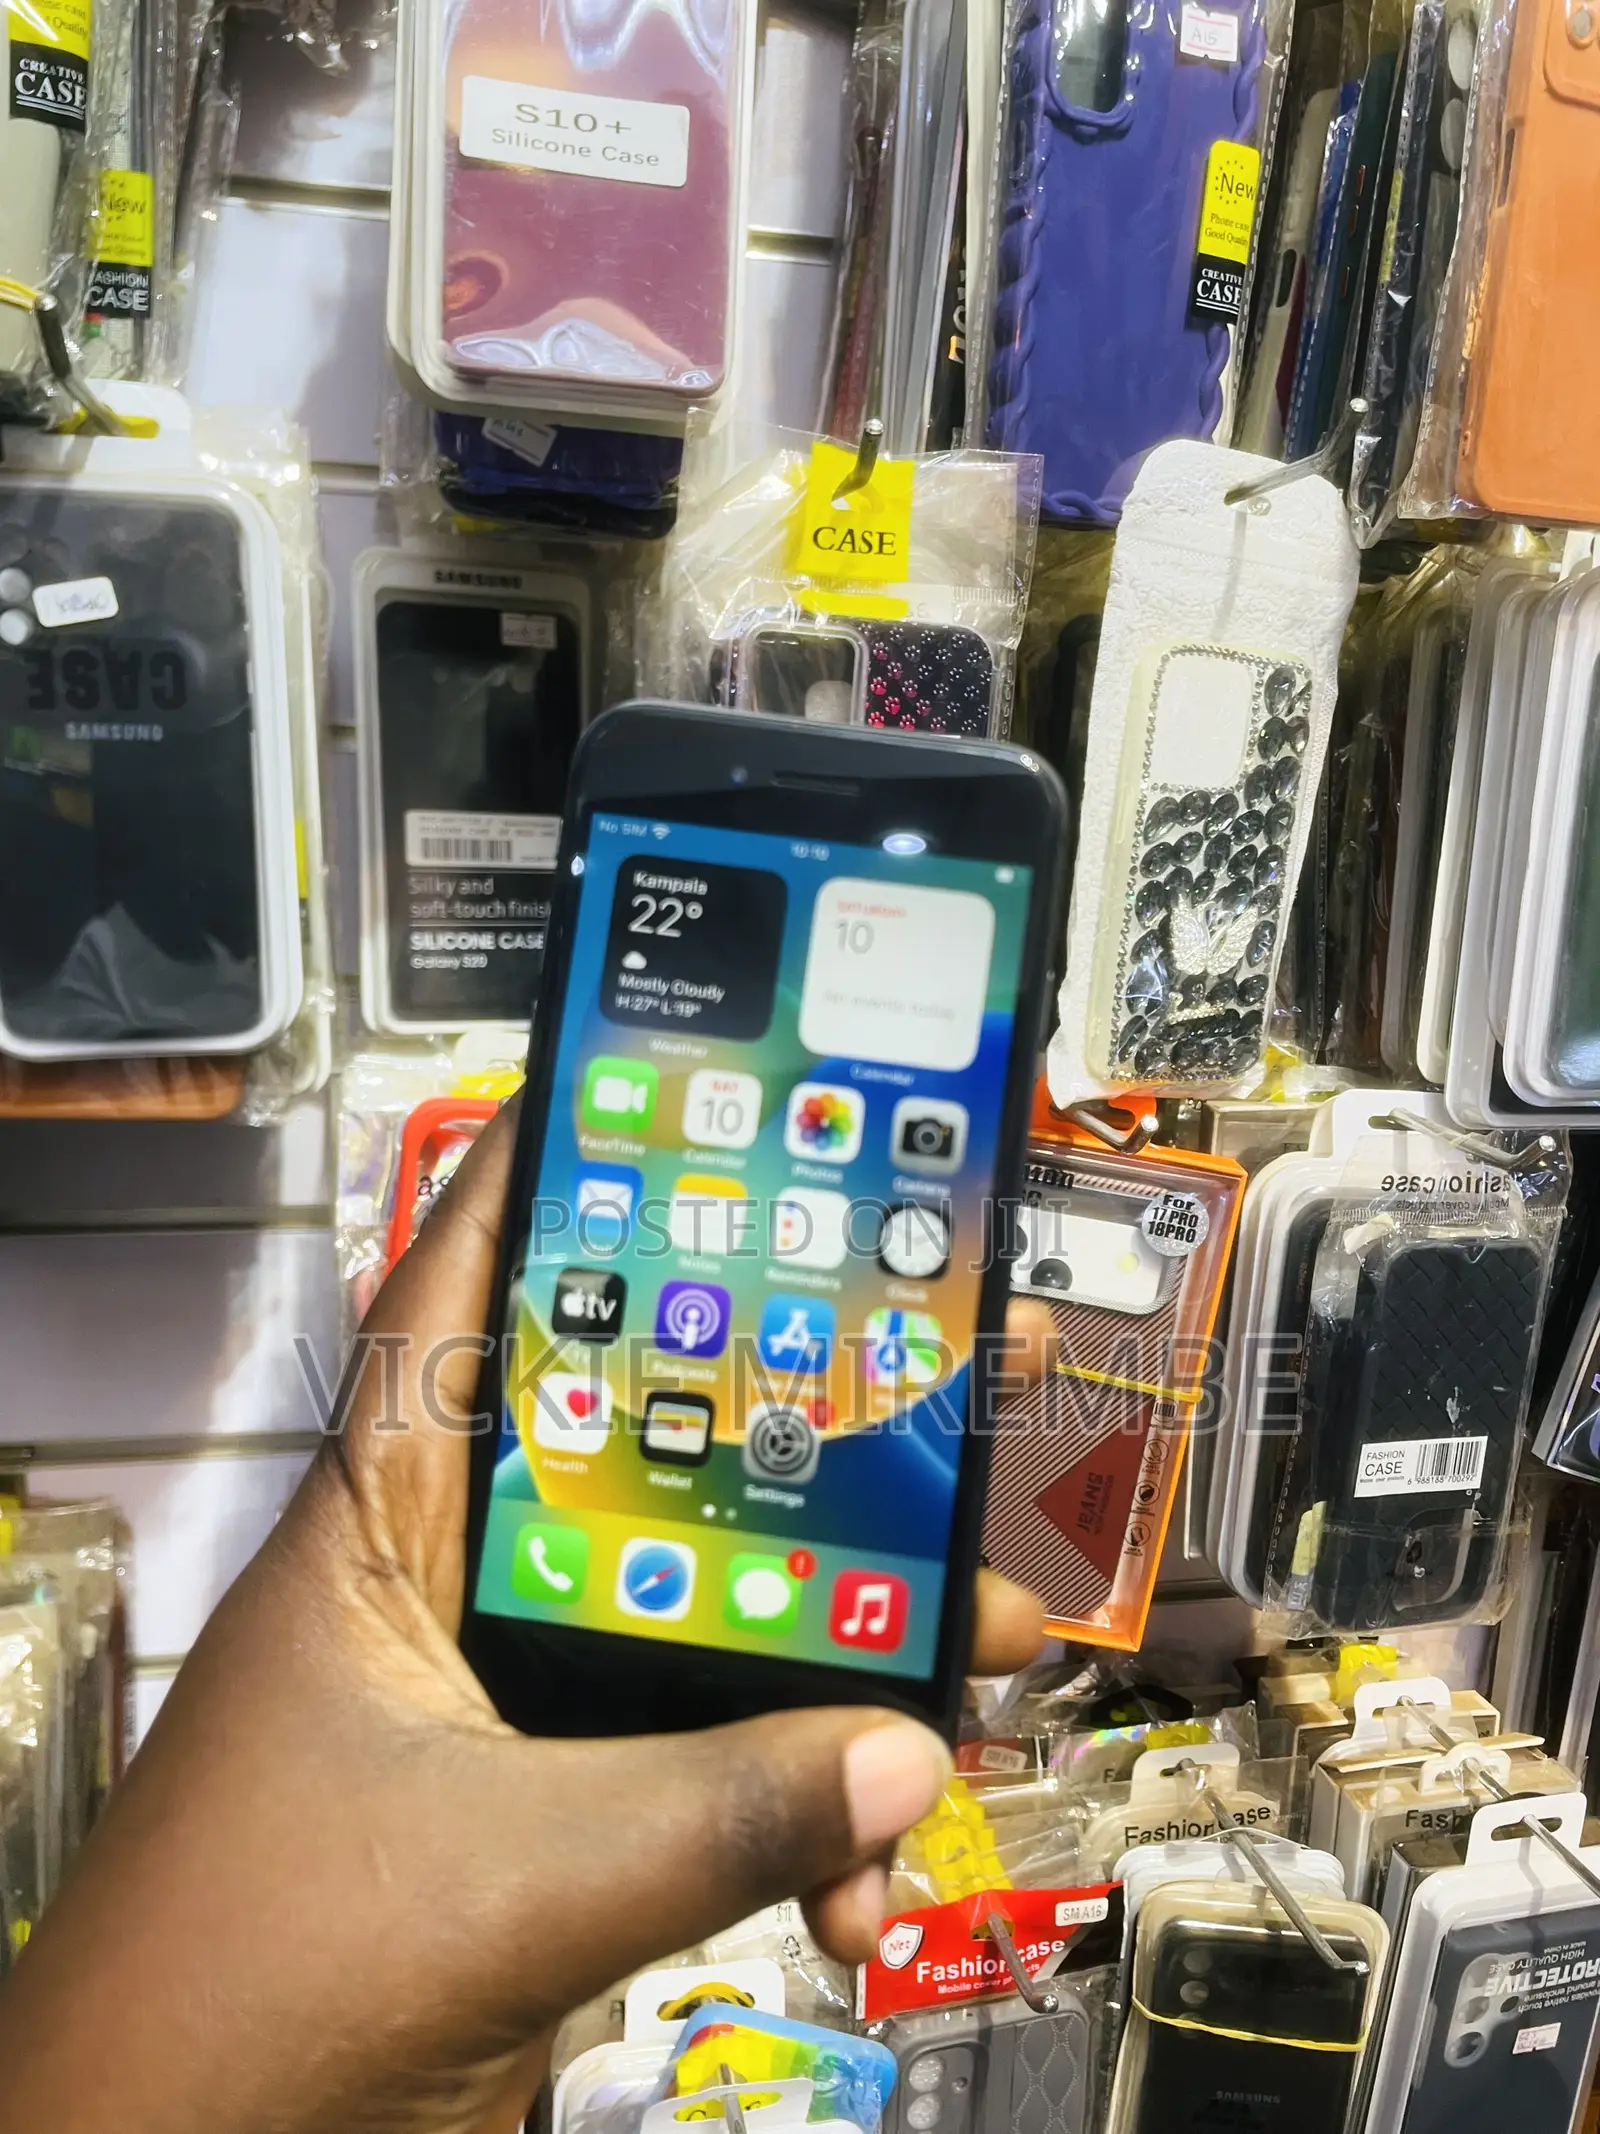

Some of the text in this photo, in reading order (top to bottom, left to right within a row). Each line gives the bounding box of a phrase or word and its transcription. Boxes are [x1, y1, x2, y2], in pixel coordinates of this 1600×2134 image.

[514, 103, 632, 135] S10+
[492, 128, 660, 168] Silicone Case
[1221, 172, 1255, 201] New
[1210, 213, 1235, 228] Phone
[1205, 227, 1226, 241] Good
[93, 270, 149, 288] ASHION
[84, 285, 149, 312] CASE
[812, 526, 898, 556] CASE
[64, 719, 164, 742] SAMSUNG
[458, 878, 494, 895] and
[633, 869, 708, 896] Kampala
[627, 893, 704, 938] 22°
[409, 931, 544, 951] SILICONE CASE
[834, 918, 875, 955] 10
[618, 972, 725, 1005] Mostly Cloudy
[701, 1098, 745, 1136] 10
[1162, 1194, 1196, 1211] For
[1152, 1206, 1199, 1229] 17 PRO
[1147, 1220, 1197, 1244] 18PRO
[542, 1456, 589, 1475] Health
[1366, 1450, 1406, 1461] FASHION
[1364, 1461, 1404, 1477] CASE
[648, 1469, 693, 1491] Wallet
[1404, 1809, 1466, 1830] Fash
[1517, 1954, 1559, 1969] QUALITY
[1560, 1948, 1585, 1961] HIGH
[937, 1981, 972, 1994] Mobile
[1566, 1981, 1597, 1996] around
[1518, 2001, 1543, 2014] touch
